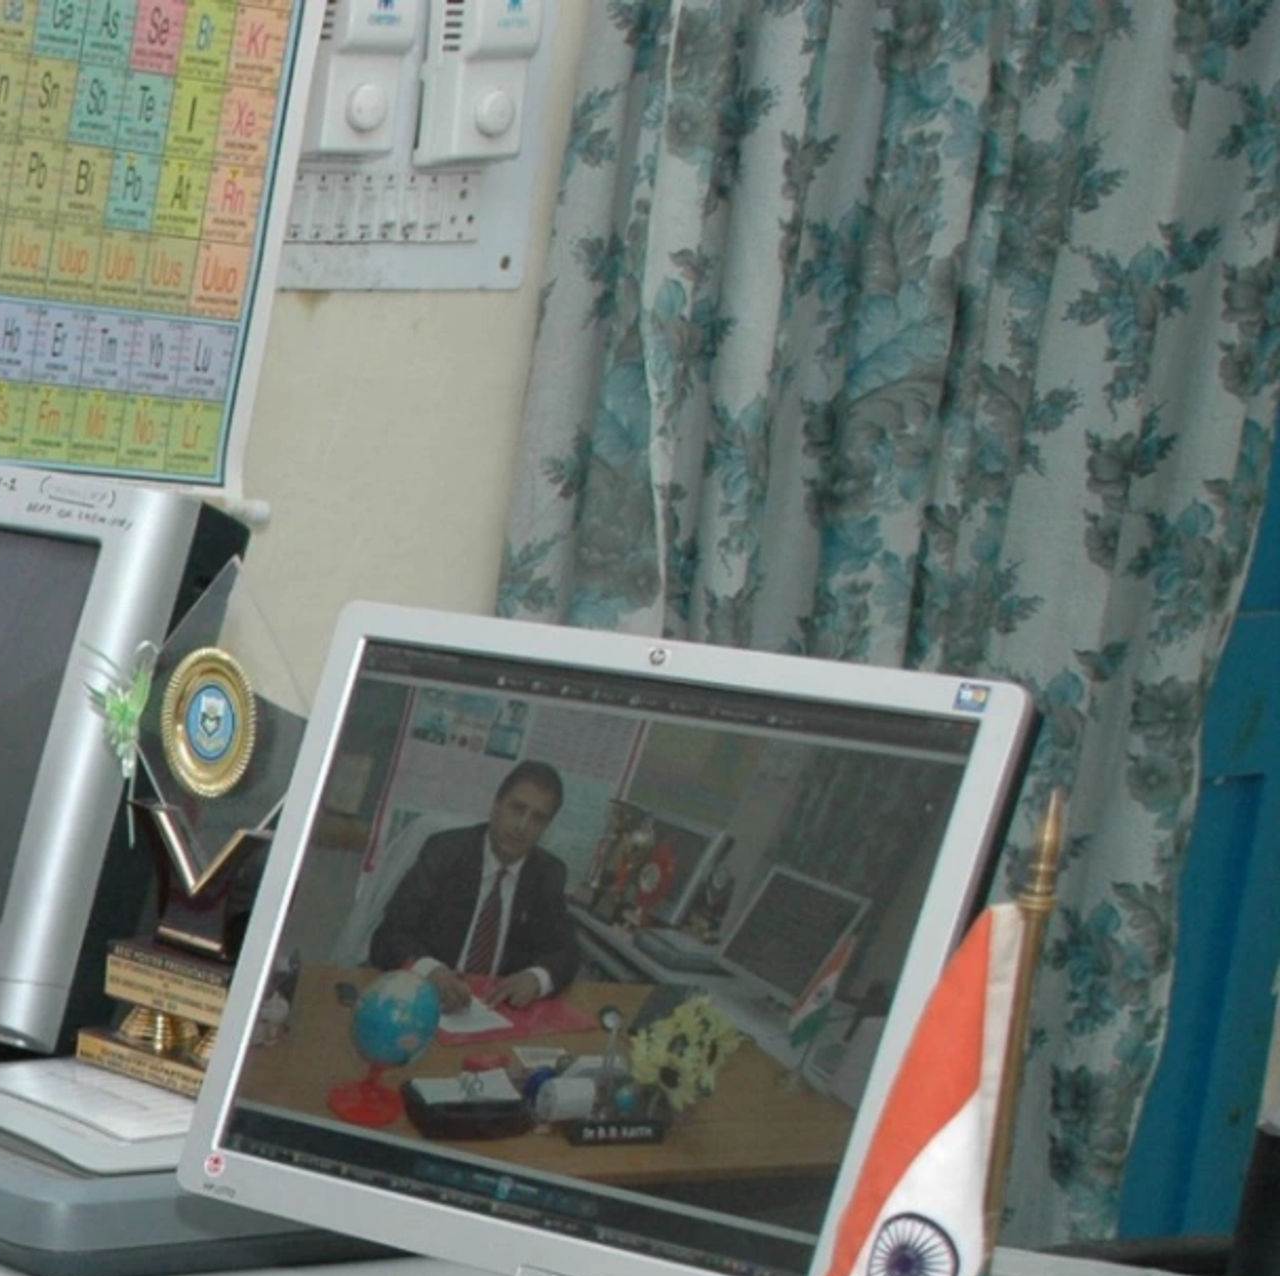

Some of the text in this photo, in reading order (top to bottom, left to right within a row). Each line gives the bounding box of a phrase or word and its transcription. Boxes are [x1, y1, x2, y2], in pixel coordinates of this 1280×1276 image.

[147, 6, 171, 46] Se
[245, 20, 273, 60] Kr
[74, 159, 96, 196] Bi
